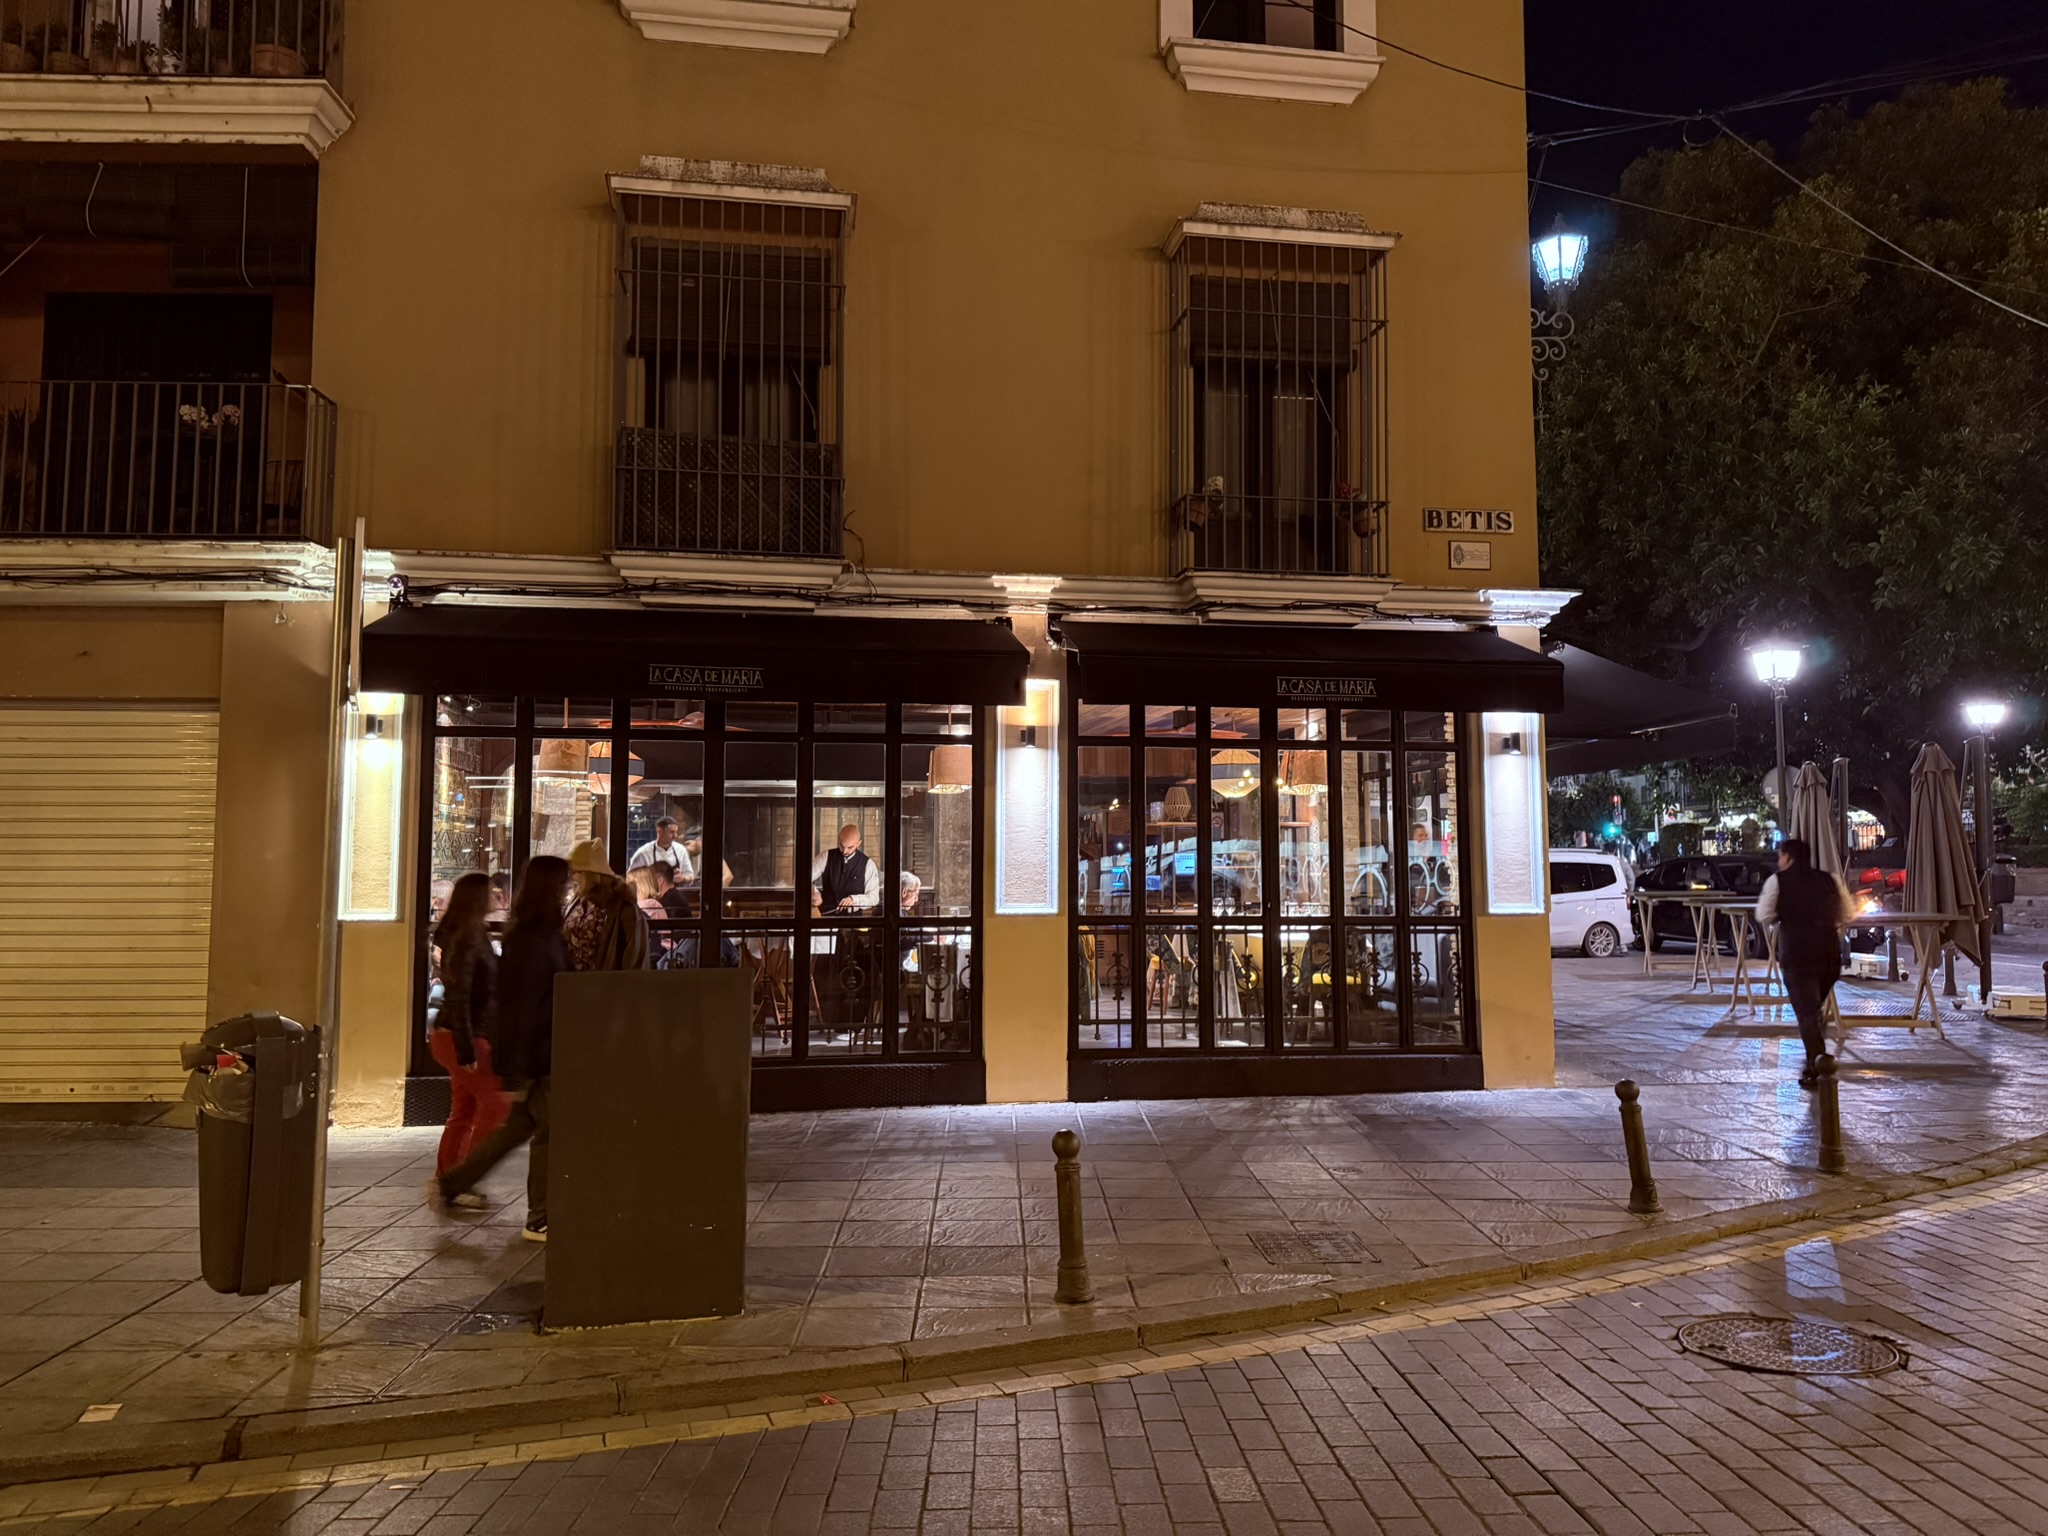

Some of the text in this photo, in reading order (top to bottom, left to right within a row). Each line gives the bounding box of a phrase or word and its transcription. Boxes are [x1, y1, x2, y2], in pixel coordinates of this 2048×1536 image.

[1426, 509, 1512, 531] BETIS
[663, 668, 702, 683] CASA
[704, 670, 719, 682] DE
[721, 670, 764, 685] MARIA
[1289, 679, 1323, 693] CASA
[1325, 681, 1337, 692] DE
[1340, 680, 1376, 694] MARIA
